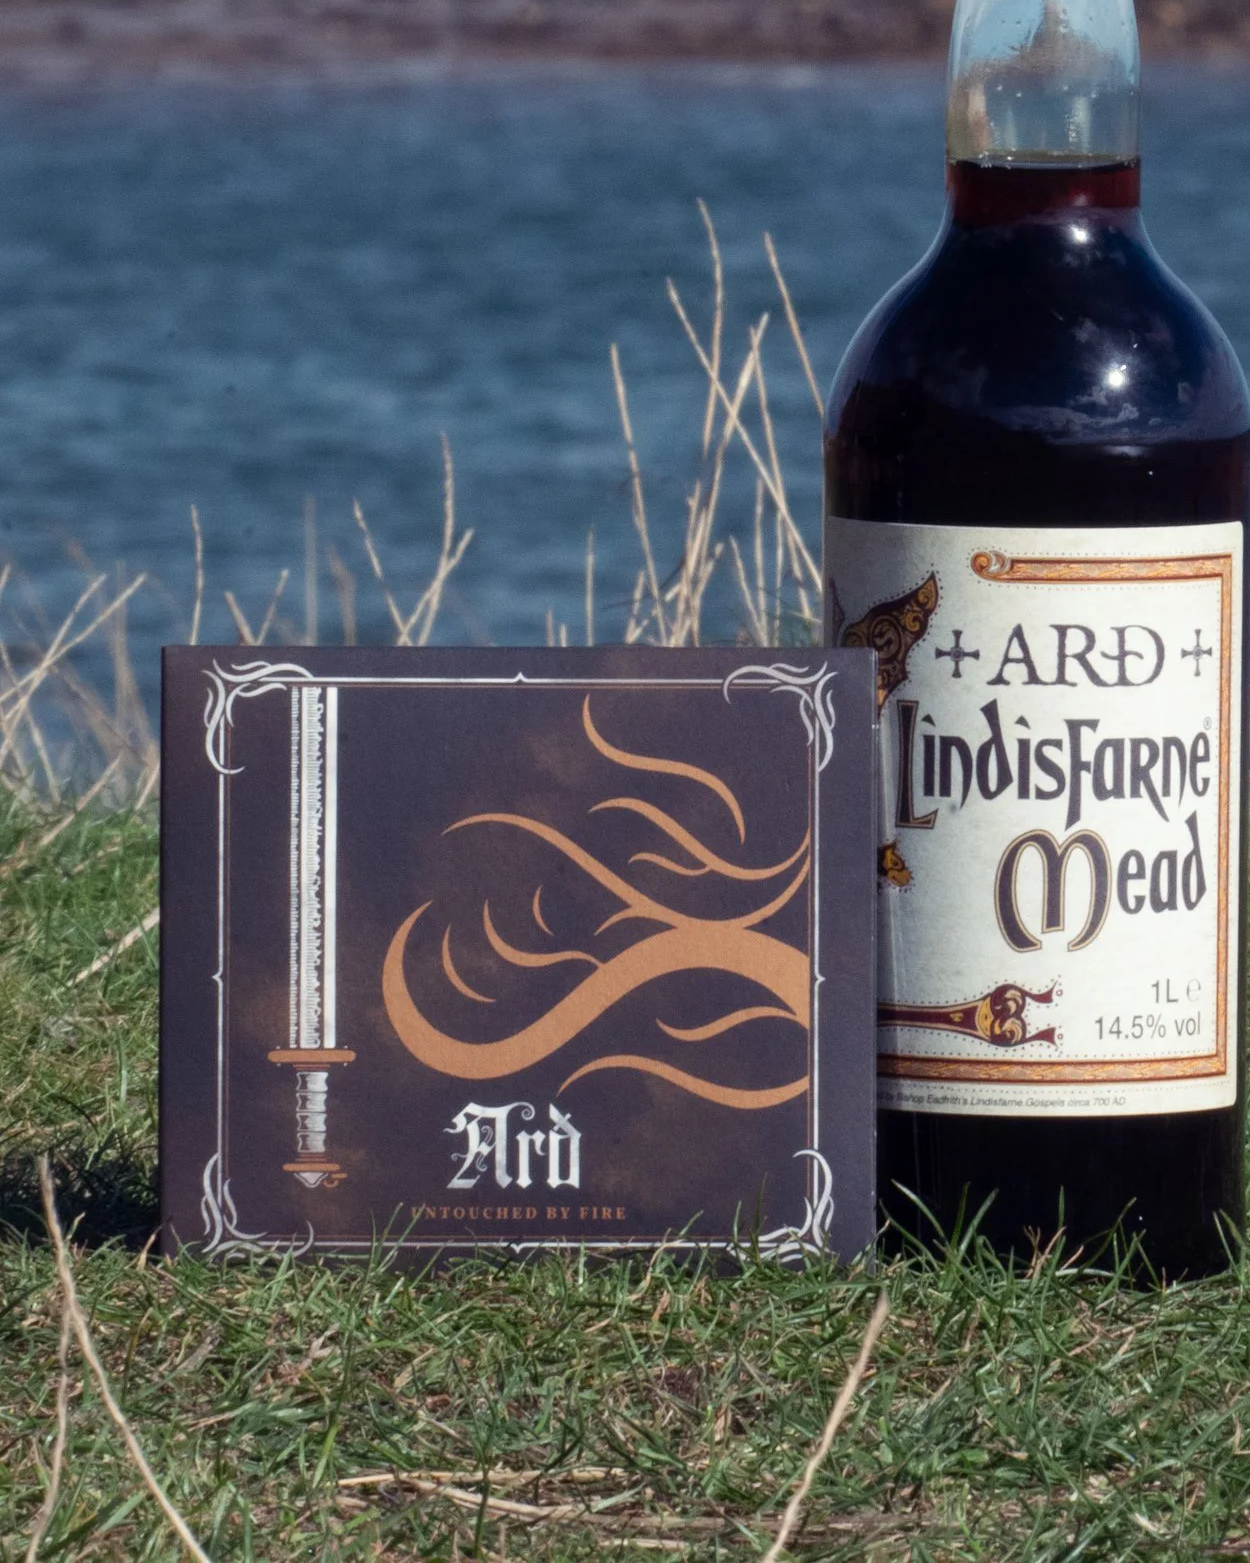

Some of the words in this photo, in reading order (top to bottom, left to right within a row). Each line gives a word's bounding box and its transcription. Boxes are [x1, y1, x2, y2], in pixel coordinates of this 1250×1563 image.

[994, 811, 1207, 953] Mead
[1095, 1014, 1167, 1040] 14.5%
[1174, 1010, 1201, 1037] vol
[546, 1205, 571, 1220] BY
[580, 1205, 627, 1220] FIRE
